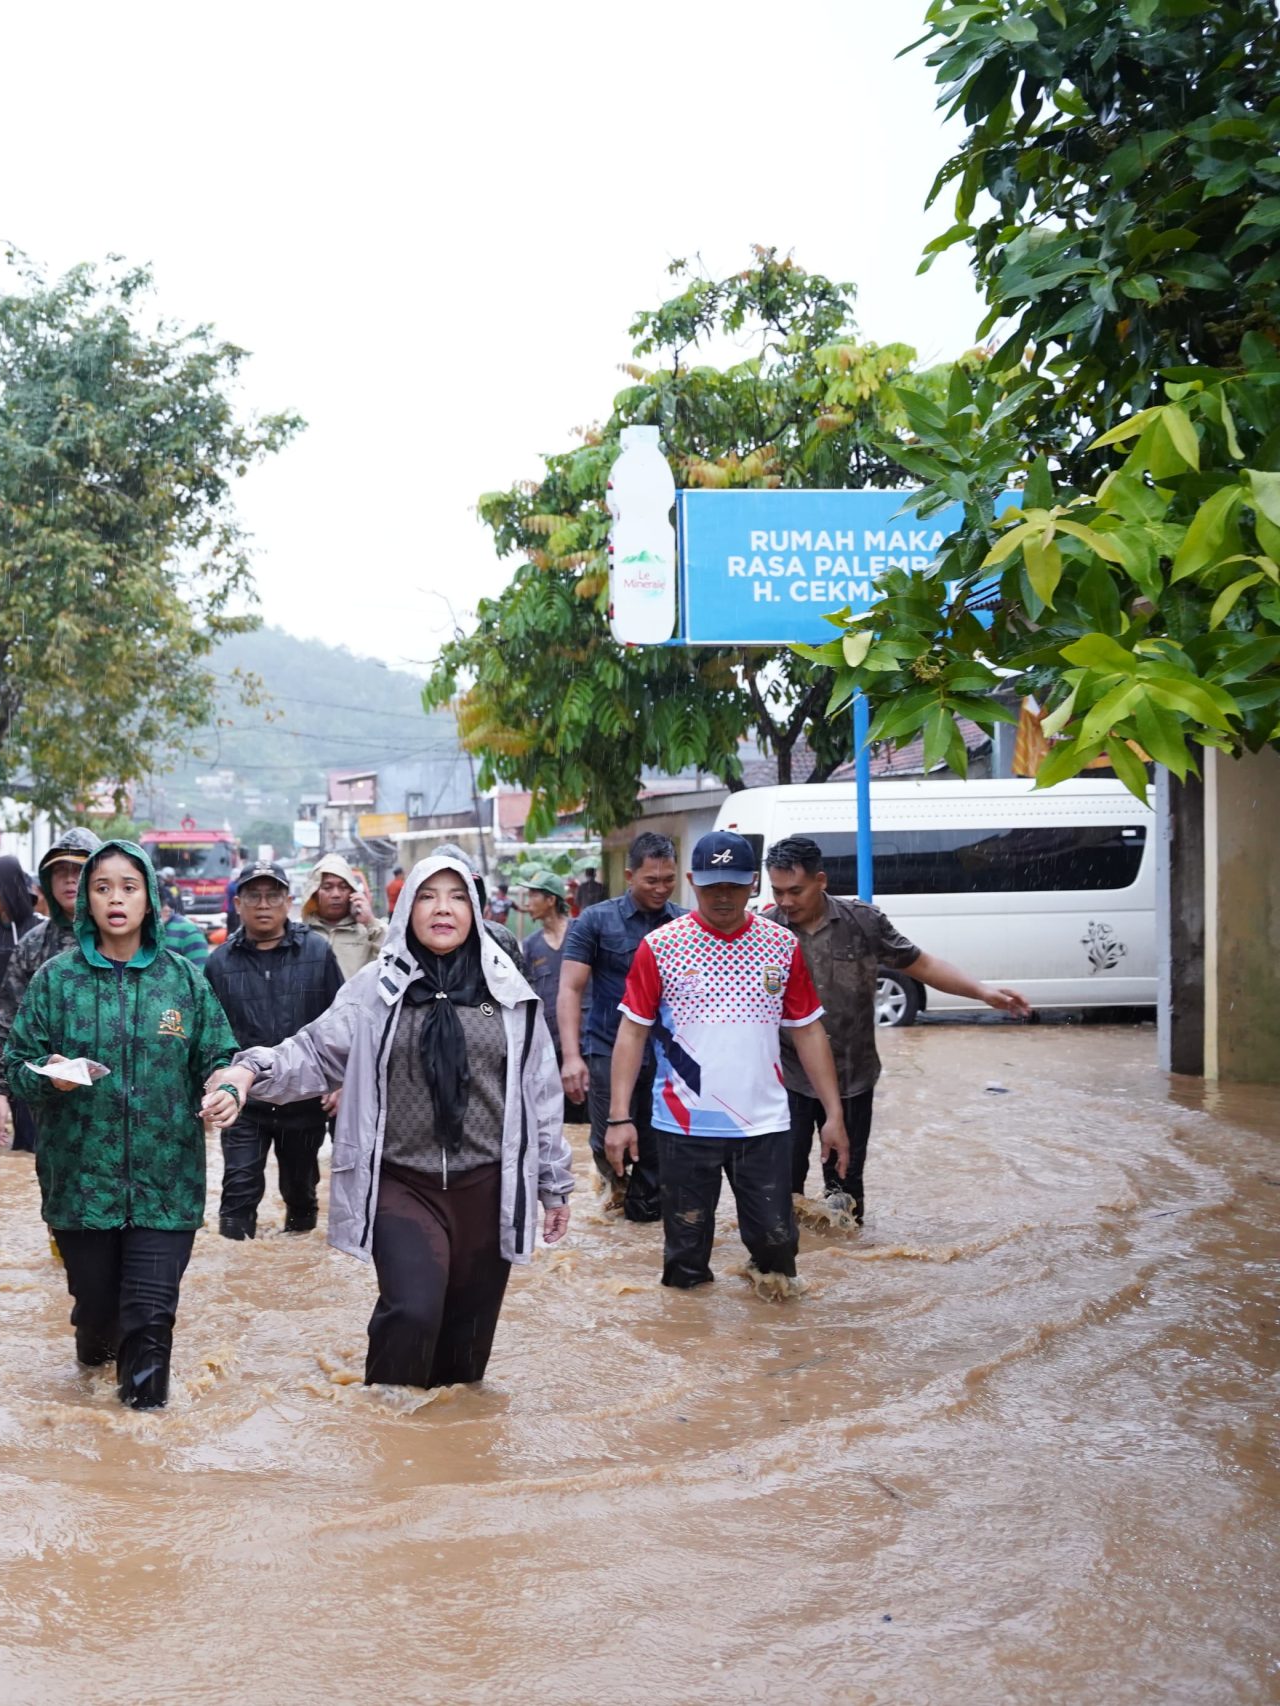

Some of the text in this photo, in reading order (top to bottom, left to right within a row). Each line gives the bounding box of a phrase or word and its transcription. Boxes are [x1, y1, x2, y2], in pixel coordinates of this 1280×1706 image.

[750, 530, 957, 551] RUMAH MAKA
[728, 556, 929, 577] RASA PALEMB
[753, 580, 781, 602] H.
